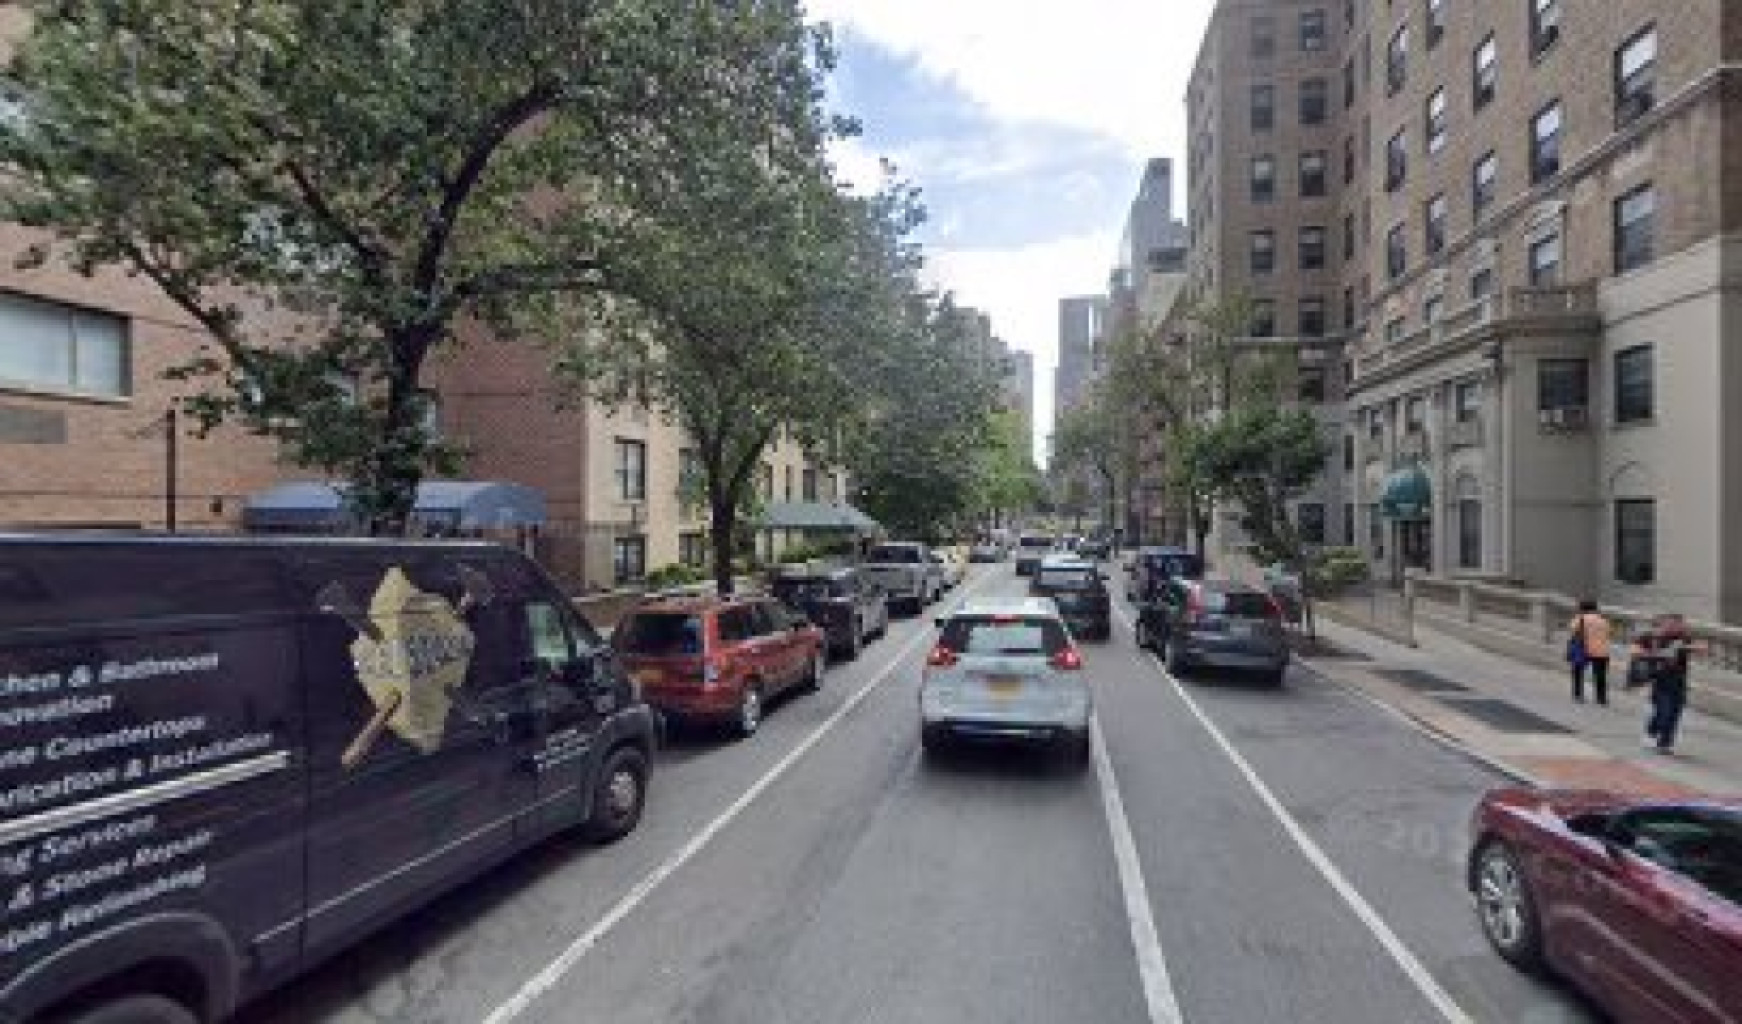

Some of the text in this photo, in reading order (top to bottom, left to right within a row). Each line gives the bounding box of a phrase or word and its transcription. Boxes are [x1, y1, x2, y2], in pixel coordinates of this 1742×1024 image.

[67, 664, 91, 688] &
[99, 653, 219, 683] Bathroom
[45, 714, 205, 760] Countertops
[124, 758, 143, 779] &
[149, 732, 274, 774] Installation
[38, 814, 157, 863] Services
[8, 883, 35, 910] &
[132, 832, 214, 868] Repair
